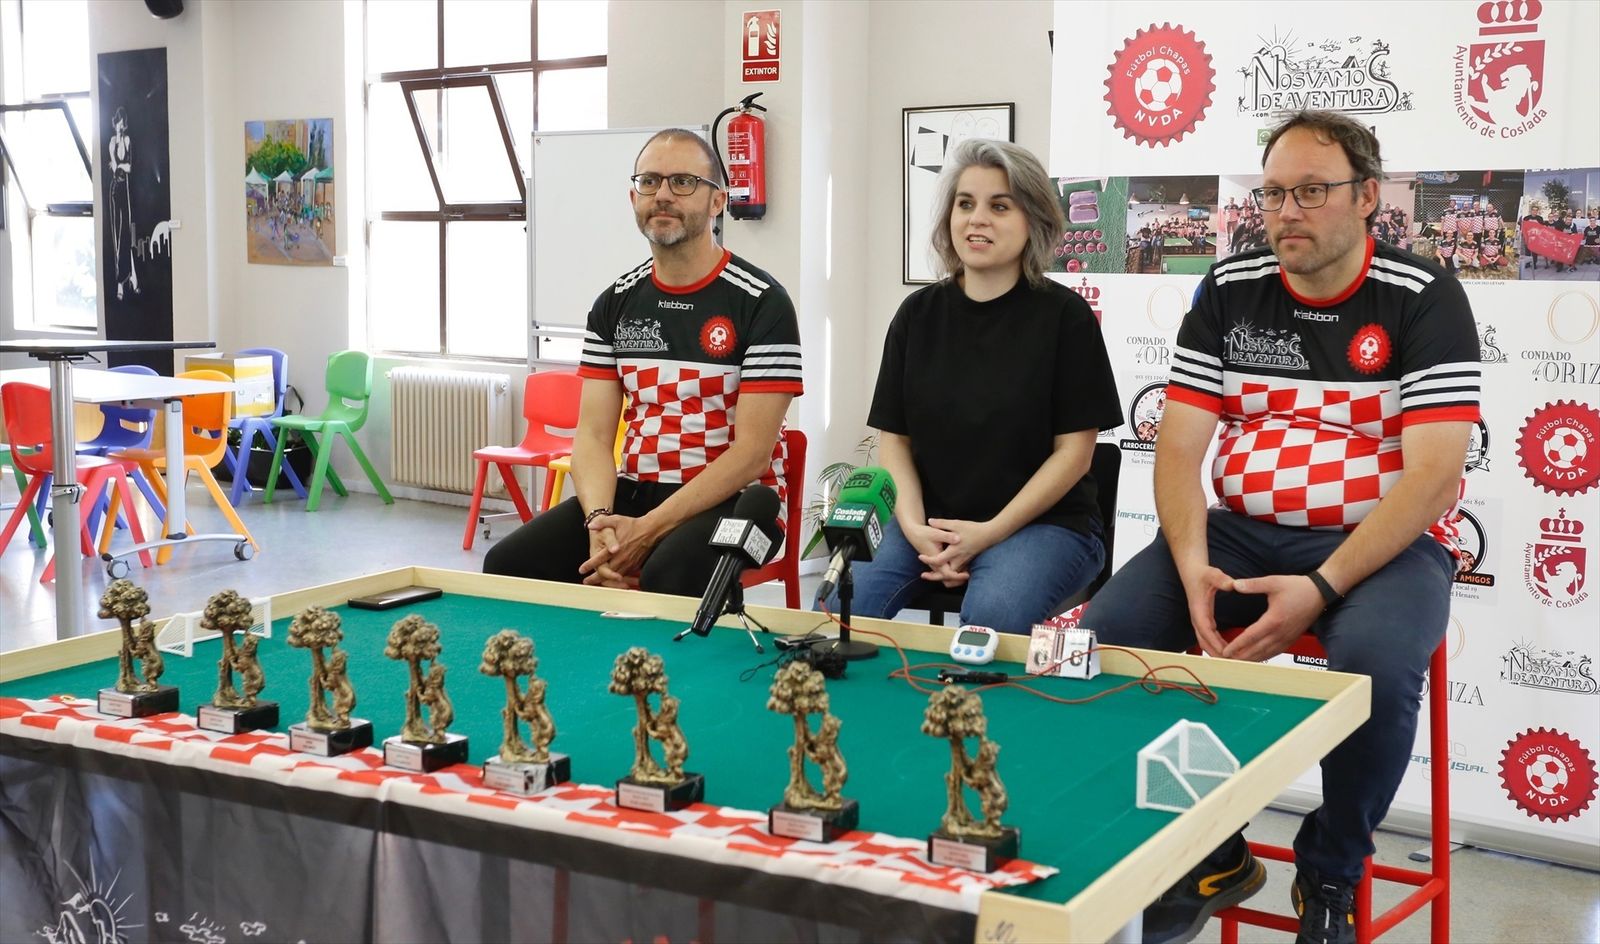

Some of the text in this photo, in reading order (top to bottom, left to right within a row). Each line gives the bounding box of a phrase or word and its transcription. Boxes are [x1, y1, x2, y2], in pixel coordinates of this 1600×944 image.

[1126, 45, 1191, 78] Fútbol Chapas
[744, 67, 777, 76] EXTINTOR
[1453, 44, 1548, 139] Ayuntamiento de Coslada
[1134, 108, 1183, 127] NVDA
[1126, 336, 1166, 345] CONDADO
[1521, 350, 1571, 361] CONDADO
[1536, 417, 1595, 443] Fútbol Chapas
[1543, 465, 1588, 480] NVDA
[835, 508, 867, 516] Coslada
[1460, 574, 1491, 585] AMIGOS
[1523, 542, 1589, 609] Ayuntamiento de Coslada
[1518, 744, 1576, 772] Fútbol Chapas
[1526, 789, 1569, 807] NVDA
